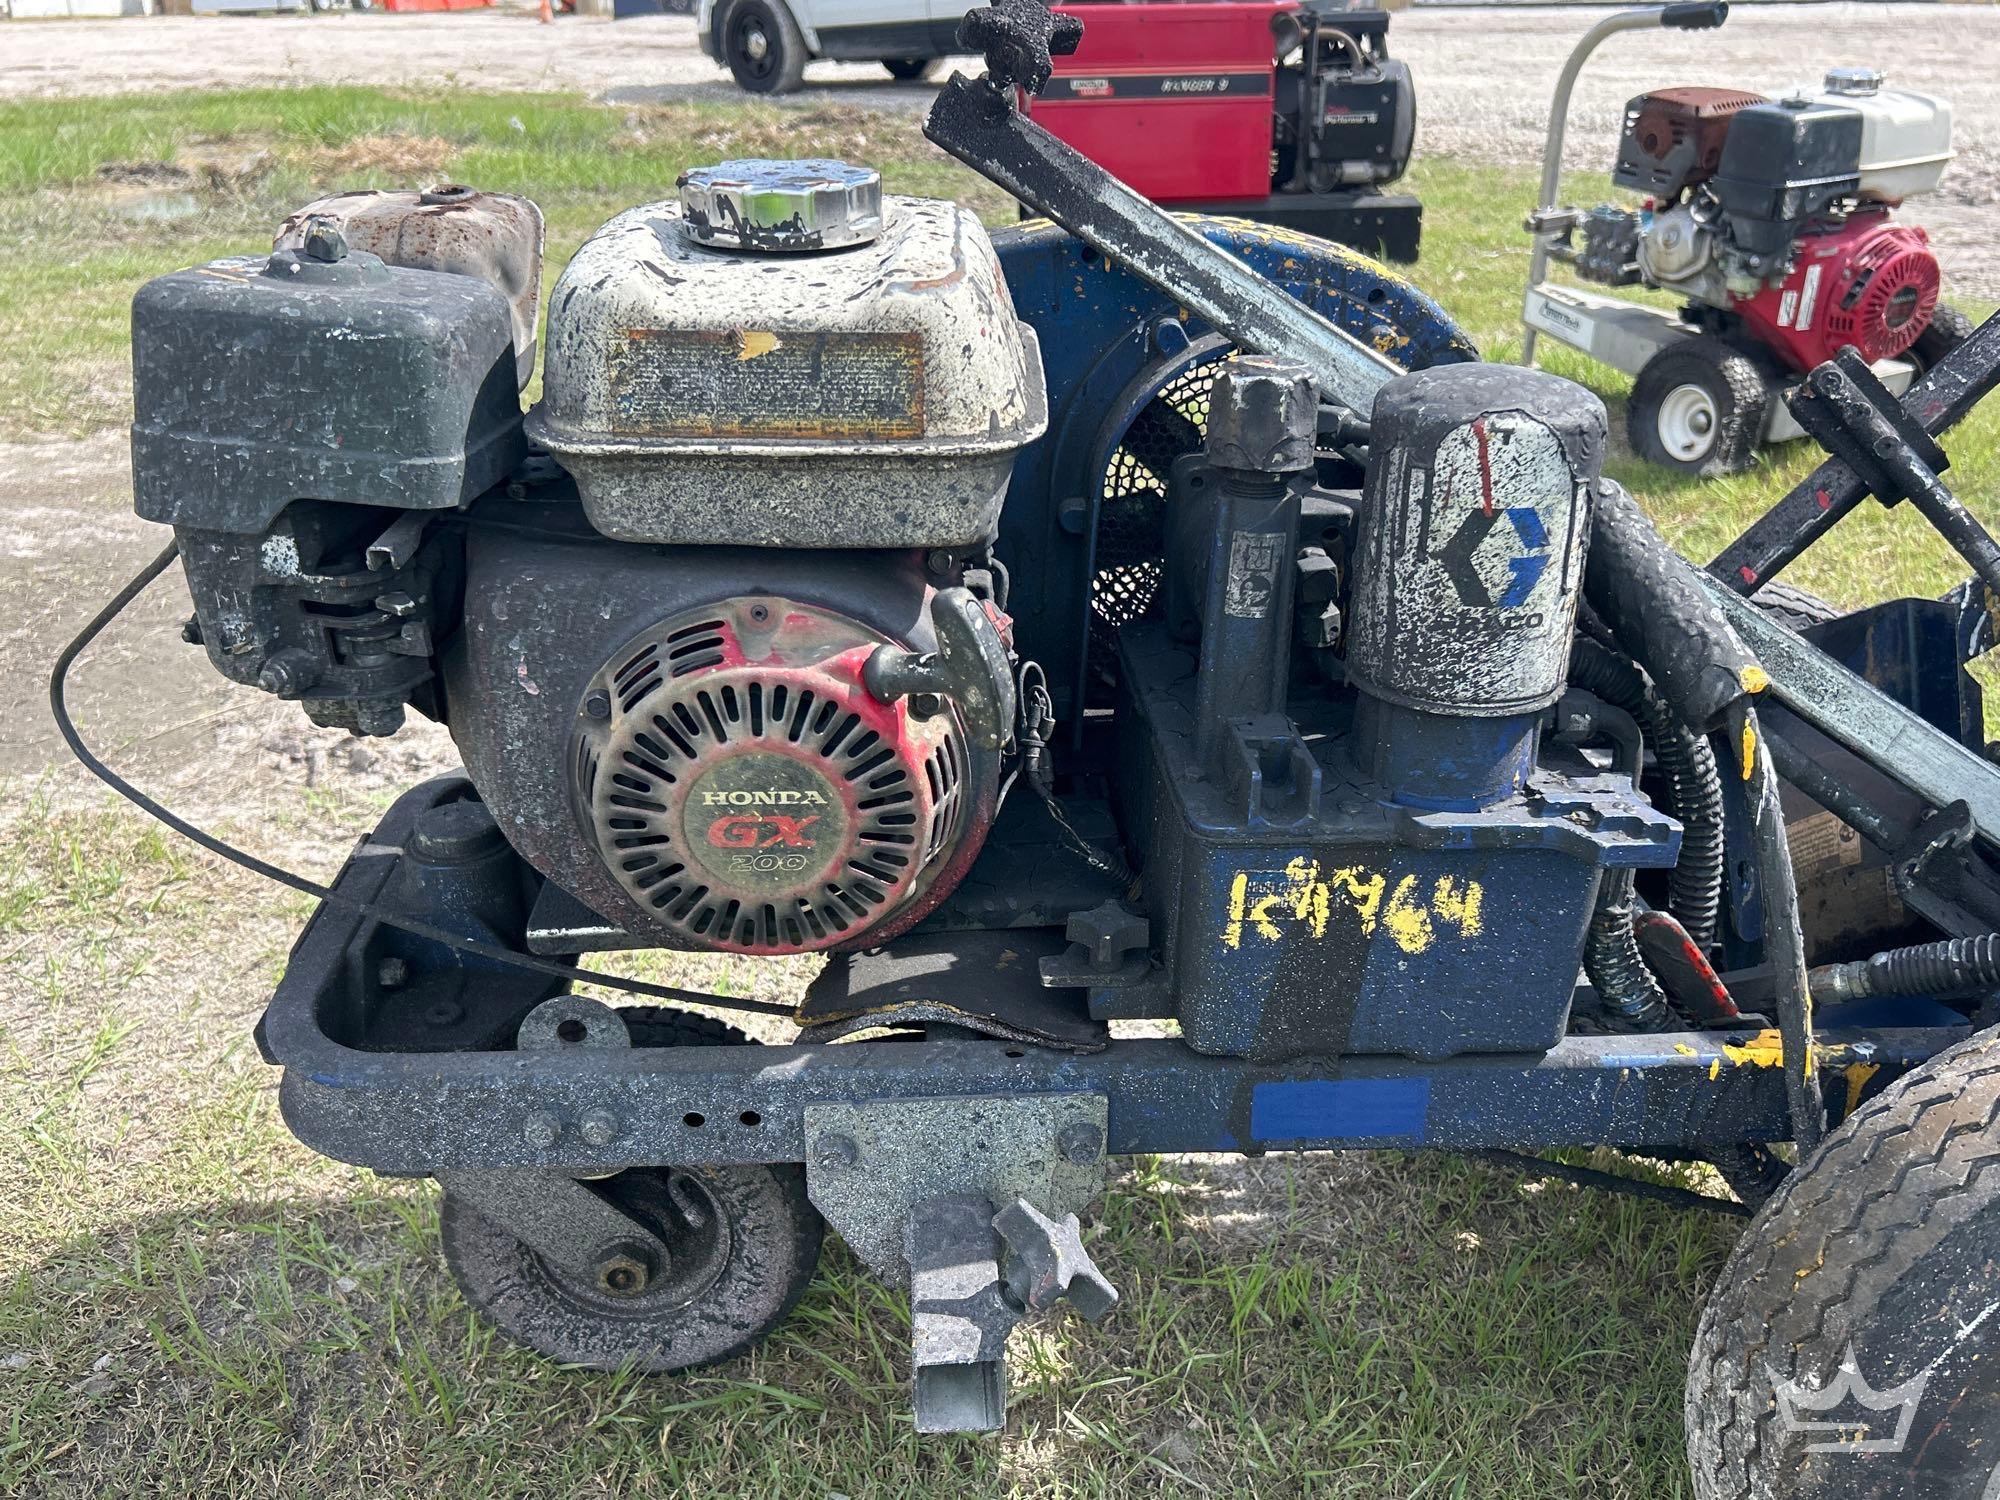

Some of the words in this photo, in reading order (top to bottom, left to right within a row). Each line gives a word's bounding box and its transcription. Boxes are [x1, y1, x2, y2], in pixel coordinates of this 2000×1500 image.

[702, 790, 828, 807] HONDA
[706, 814, 822, 849] GX
[728, 853, 807, 873] 200
